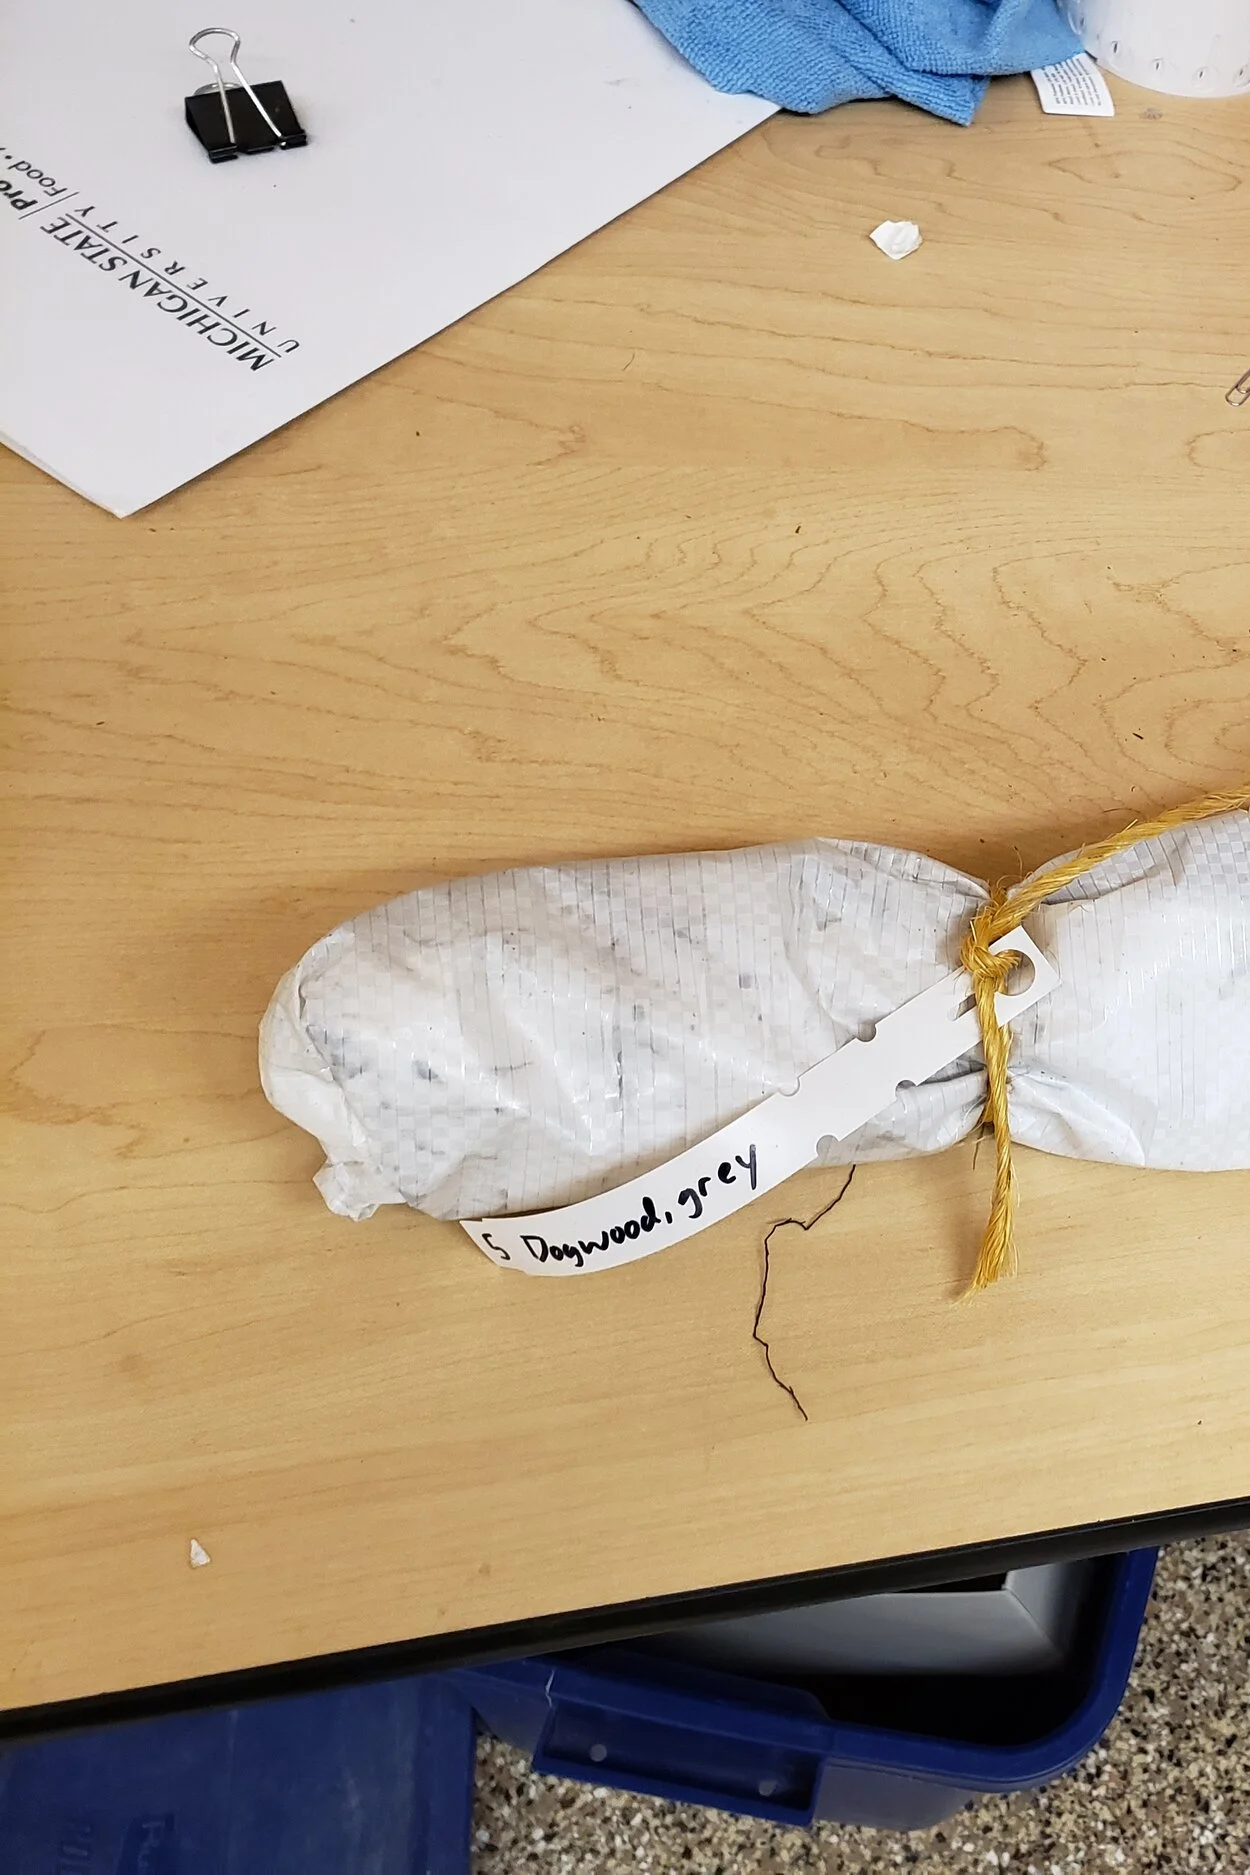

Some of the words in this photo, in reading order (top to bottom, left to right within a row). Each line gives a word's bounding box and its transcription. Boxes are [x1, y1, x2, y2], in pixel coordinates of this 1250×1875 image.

[7, 160, 68, 197] Food
[39, 216, 128, 272] STATE
[73, 205, 301, 354] UNIVERSITY
[117, 269, 276, 373] MICHIGAN
[677, 1143, 757, 1219] grey
